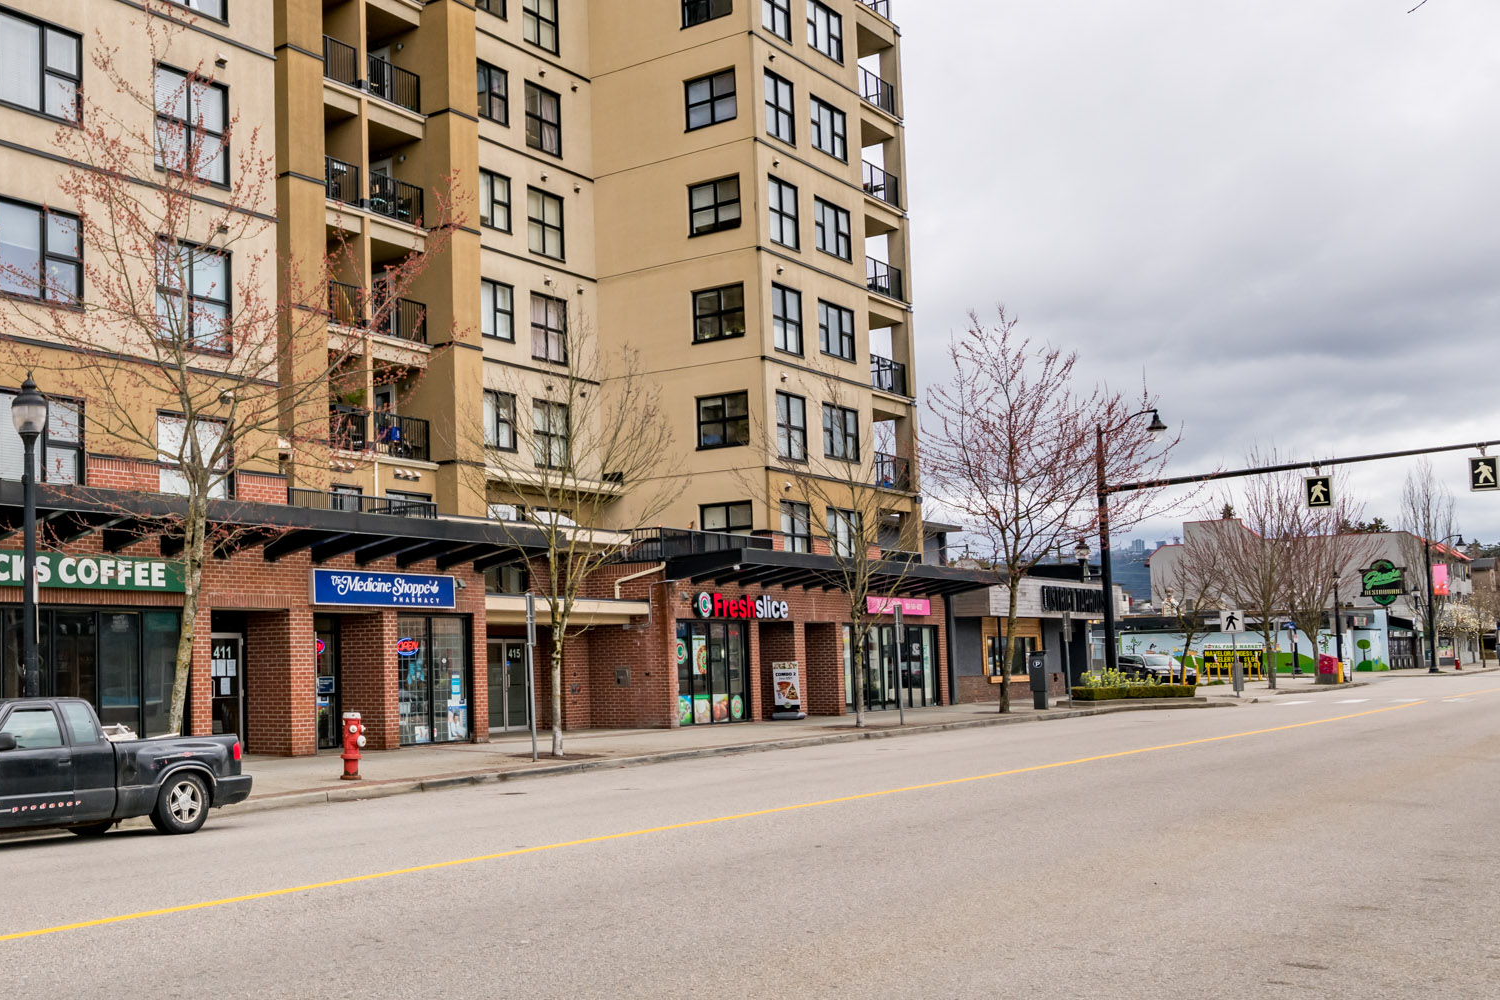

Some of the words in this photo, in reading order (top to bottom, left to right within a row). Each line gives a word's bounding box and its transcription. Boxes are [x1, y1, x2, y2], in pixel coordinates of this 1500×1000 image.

[58, 557, 166, 587] COFFEE
[337, 575, 392, 595] Medicine
[392, 577, 431, 597] Shoppe
[393, 596, 440, 604] PHARMACY
[713, 592, 789, 619] Freshslice
[213, 645, 231, 659] 411
[397, 640, 419, 652] OPEN
[508, 648, 521, 659] 415
